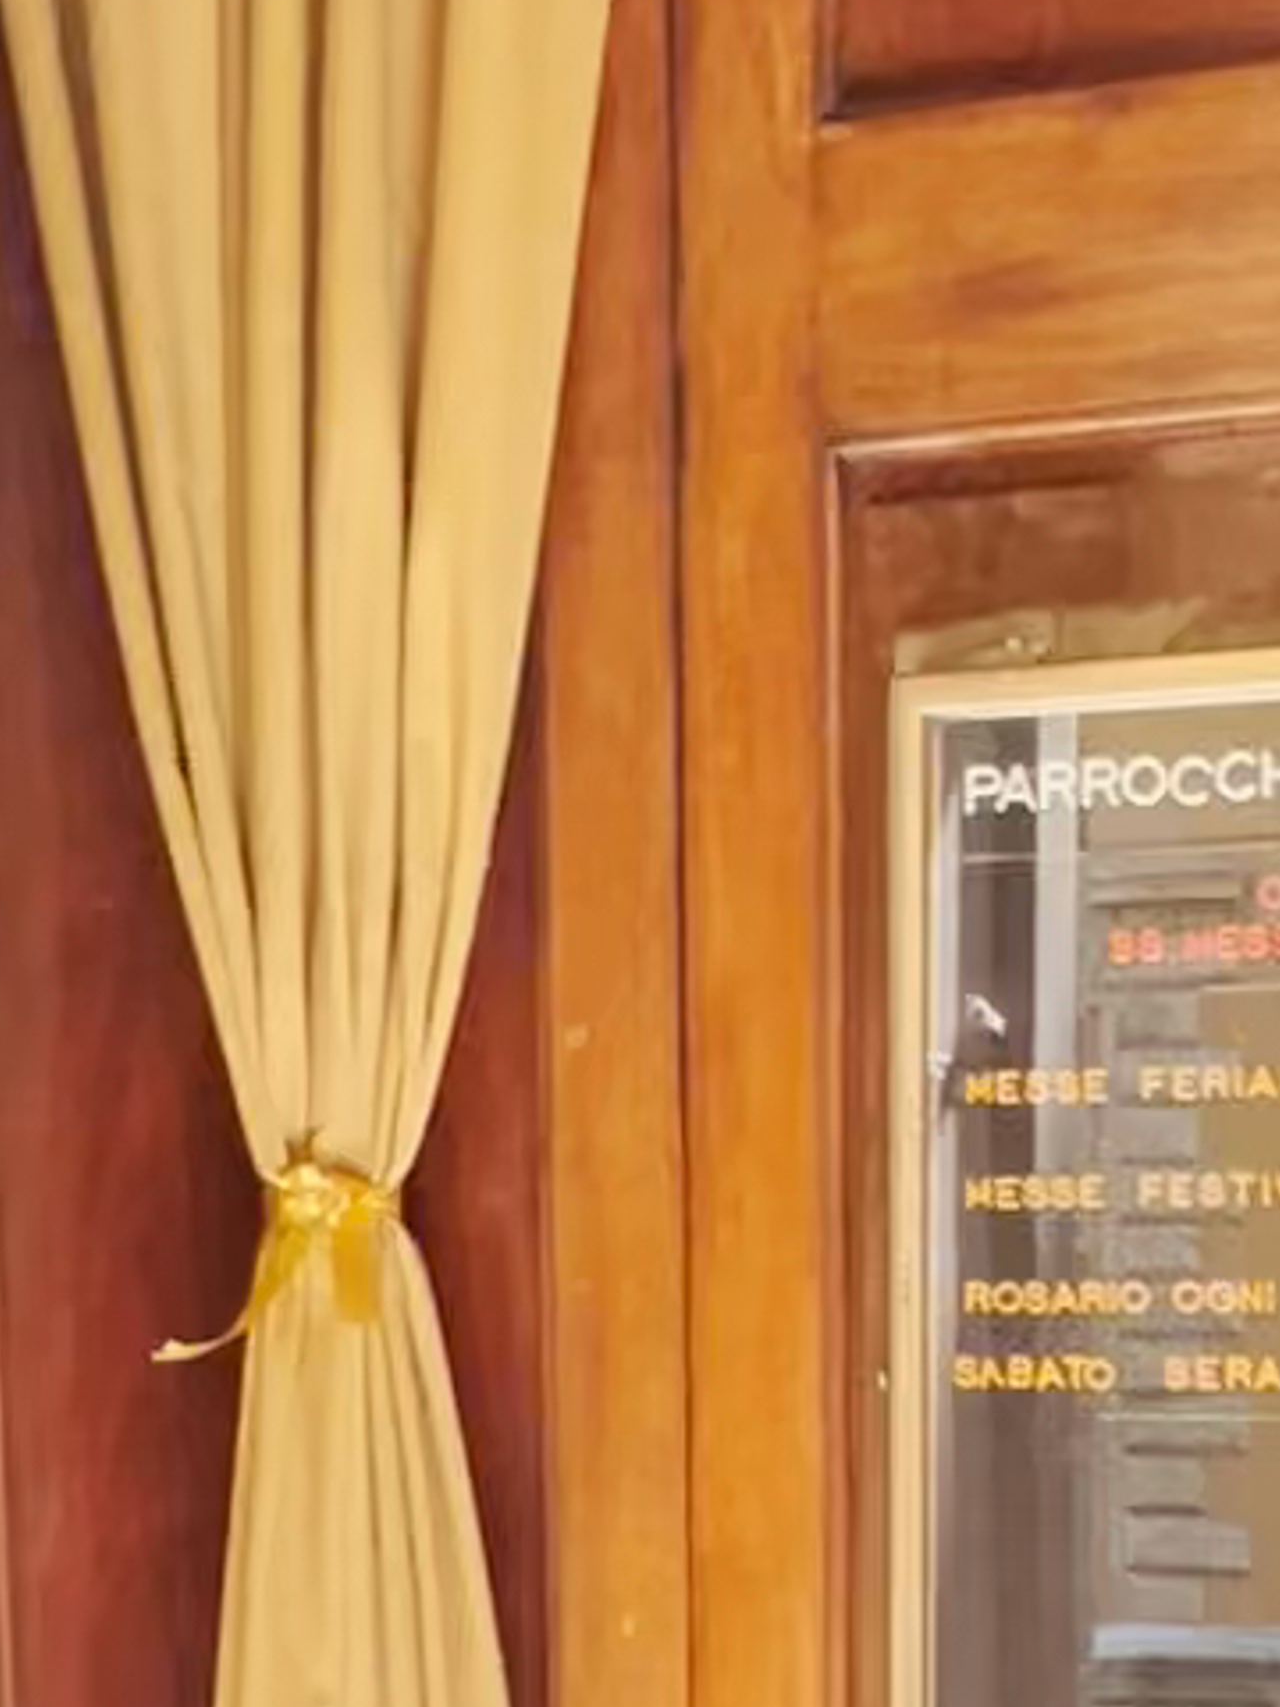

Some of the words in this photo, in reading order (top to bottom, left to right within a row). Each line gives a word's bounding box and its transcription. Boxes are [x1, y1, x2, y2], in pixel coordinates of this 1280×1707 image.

[964, 1067, 1109, 1106] MESSE
[964, 1173, 1107, 1211] MESSE
[963, 1279, 1152, 1316] ROSARIO
[1170, 1278, 1277, 1315] OGNI
[952, 1354, 1116, 1391] SABATO
